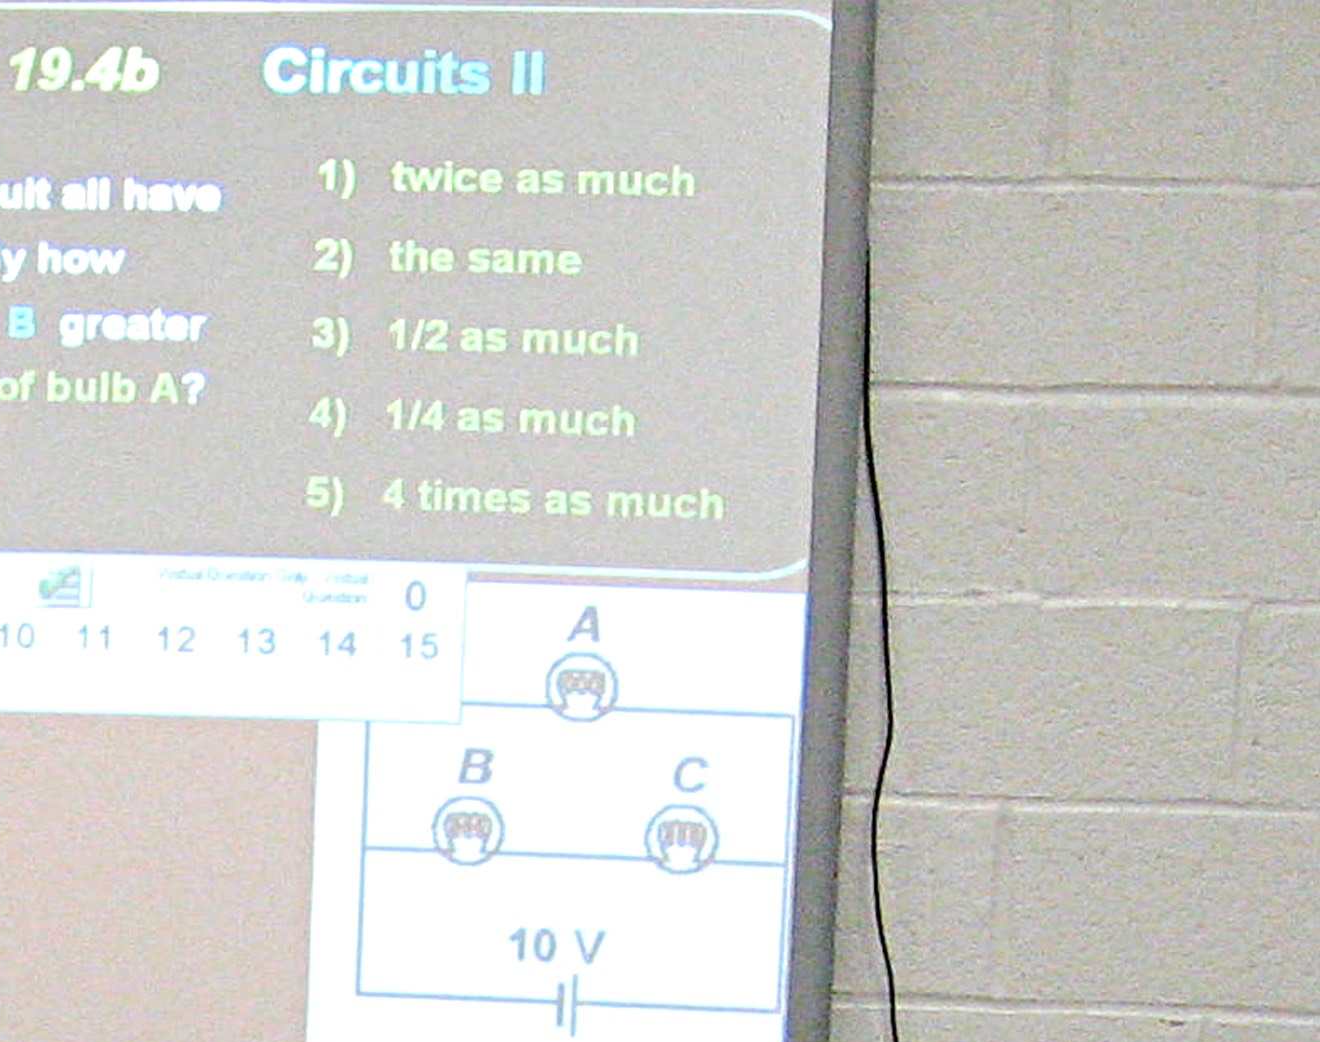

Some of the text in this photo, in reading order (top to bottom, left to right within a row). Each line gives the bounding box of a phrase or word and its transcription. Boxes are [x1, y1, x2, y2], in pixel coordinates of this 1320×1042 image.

[10, 47, 159, 93] 19.4b
[263, 46, 543, 95] Circuits II
[62, 176, 112, 210] all
[124, 176, 225, 212] have
[319, 159, 694, 198] 1) twice as much
[38, 240, 127, 275] how
[314, 238, 582, 279] 2) the same
[9, 304, 35, 338] B
[60, 308, 209, 347] greater
[313, 317, 638, 357] 3) 1/2 as much
[47, 371, 136, 403] bulb
[150, 369, 208, 404] A?
[309, 397, 634, 437] 4) 1/4 as much
[307, 476, 723, 519] 5) 4 times as much
[405, 580, 427, 611] 0
[0, 623, 35, 649] 10
[79, 625, 110, 648] 11
[159, 626, 195, 652] 12
[240, 627, 276, 655] 13
[320, 631, 356, 656] 14
[401, 633, 438, 659] 15
[567, 605, 600, 642] A
[459, 748, 494, 784] B
[673, 756, 709, 793] C
[510, 928, 606, 965] 10 V
